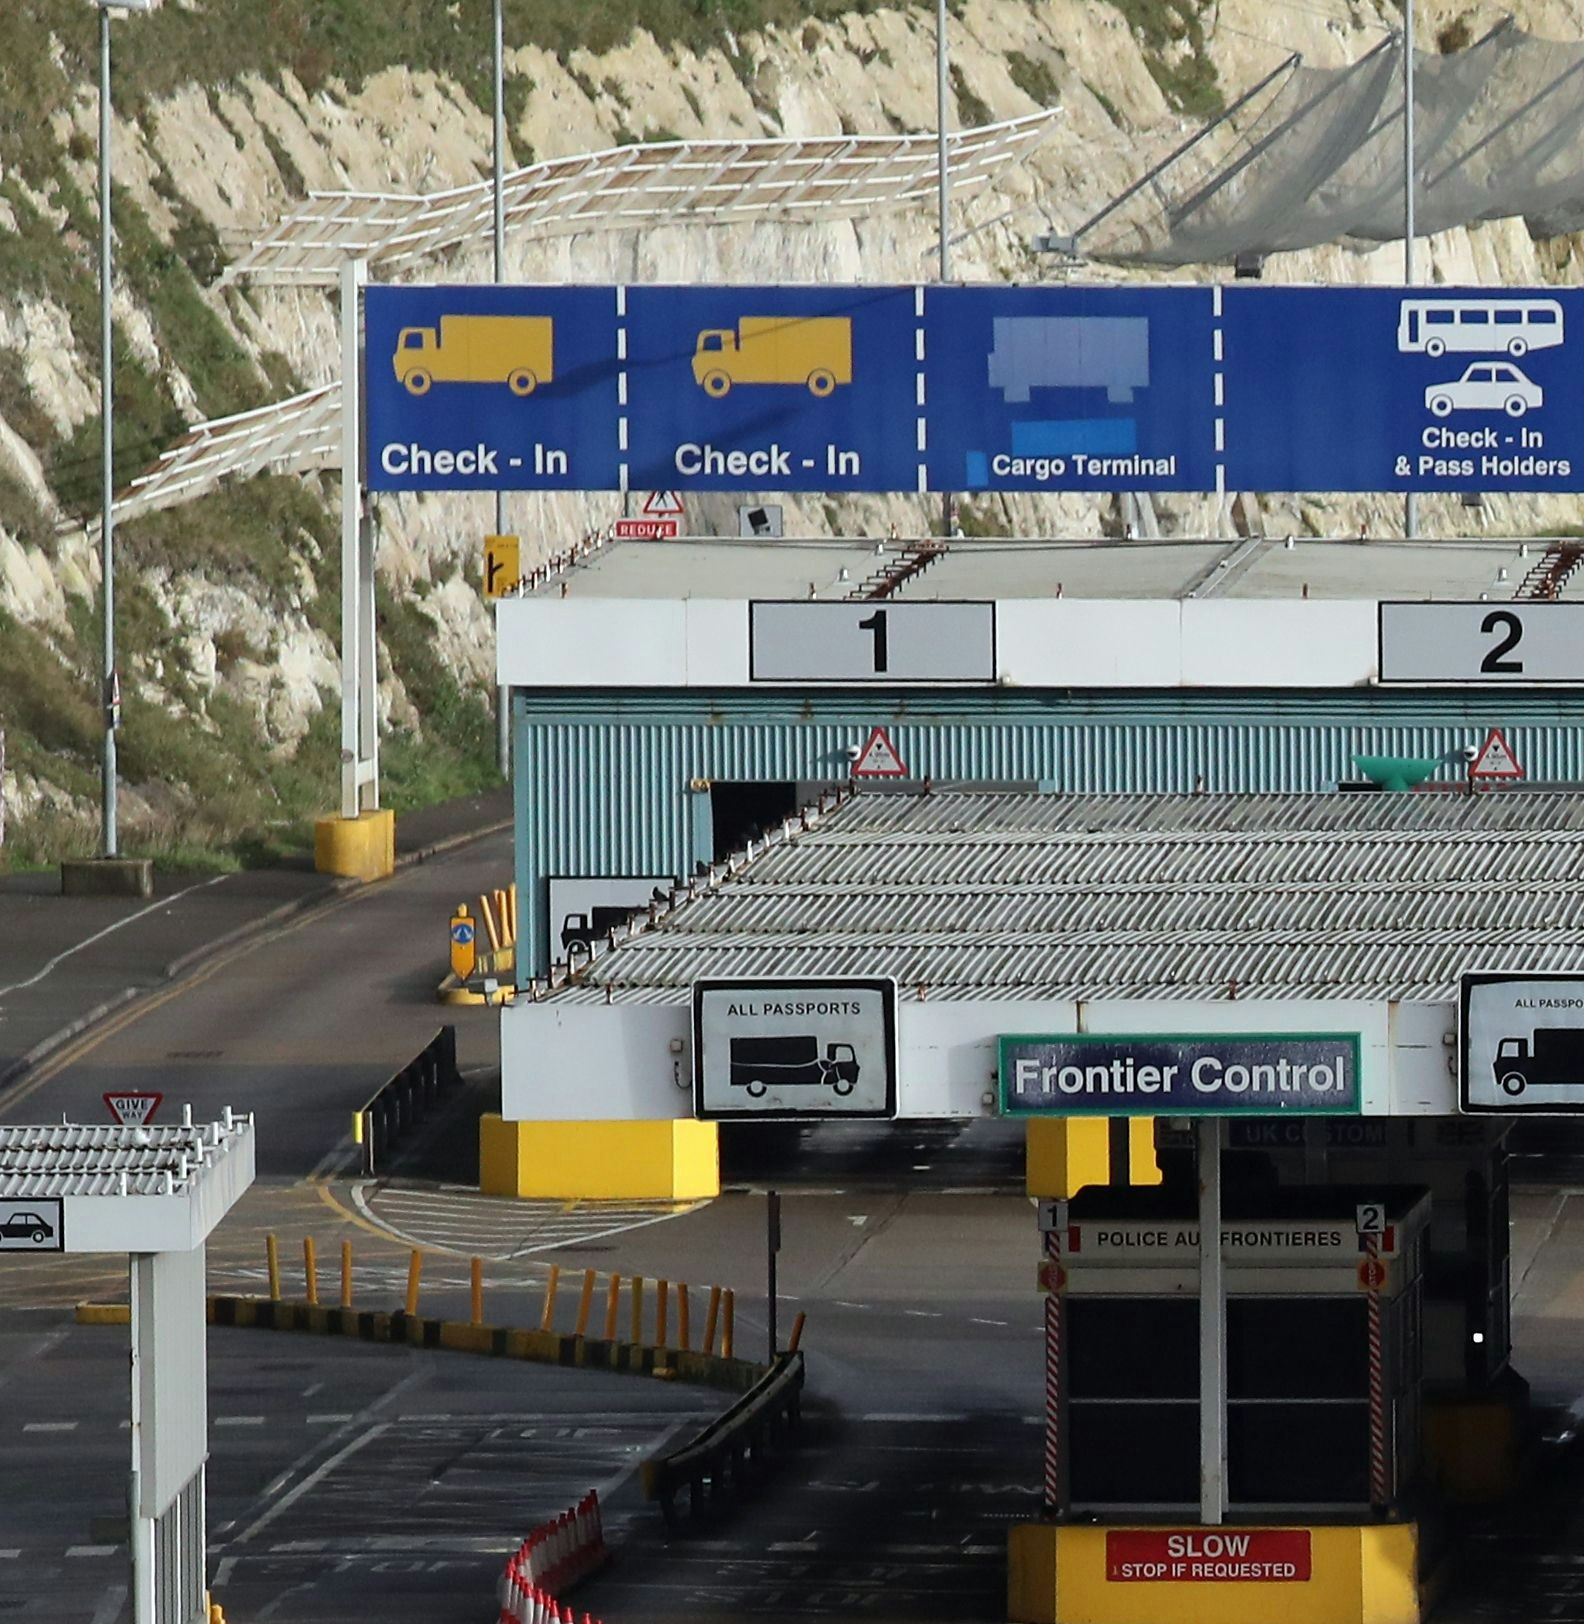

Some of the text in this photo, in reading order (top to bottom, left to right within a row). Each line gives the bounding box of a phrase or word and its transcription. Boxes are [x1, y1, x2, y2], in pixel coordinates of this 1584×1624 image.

[1421, 427, 1498, 450] Check
[1521, 428, 1543, 449] In
[381, 443, 498, 475] Check
[534, 443, 568, 474] In
[674, 443, 790, 475] Check
[827, 444, 860, 475] In
[991, 455, 1176, 480] Cargo Terminal
[1394, 455, 1571, 476] & Pass Holders
[858, 609, 887, 673] 1
[1479, 610, 1524, 674] 2
[728, 1001, 862, 1017] ALL PASSPORTS
[1514, 998, 1536, 1009] ALL
[1017, 1055, 1345, 1094] Frontier Control
[116, 1100, 147, 1110] GIVE
[1047, 1207, 1057, 1228] 1
[1362, 1208, 1379, 1230] 2
[1098, 1231, 1342, 1247] POLICE AU FRONTIERES
[1167, 1535, 1250, 1558] SLOW
[1122, 1563, 1296, 1579] STOP IF REQUESTED
